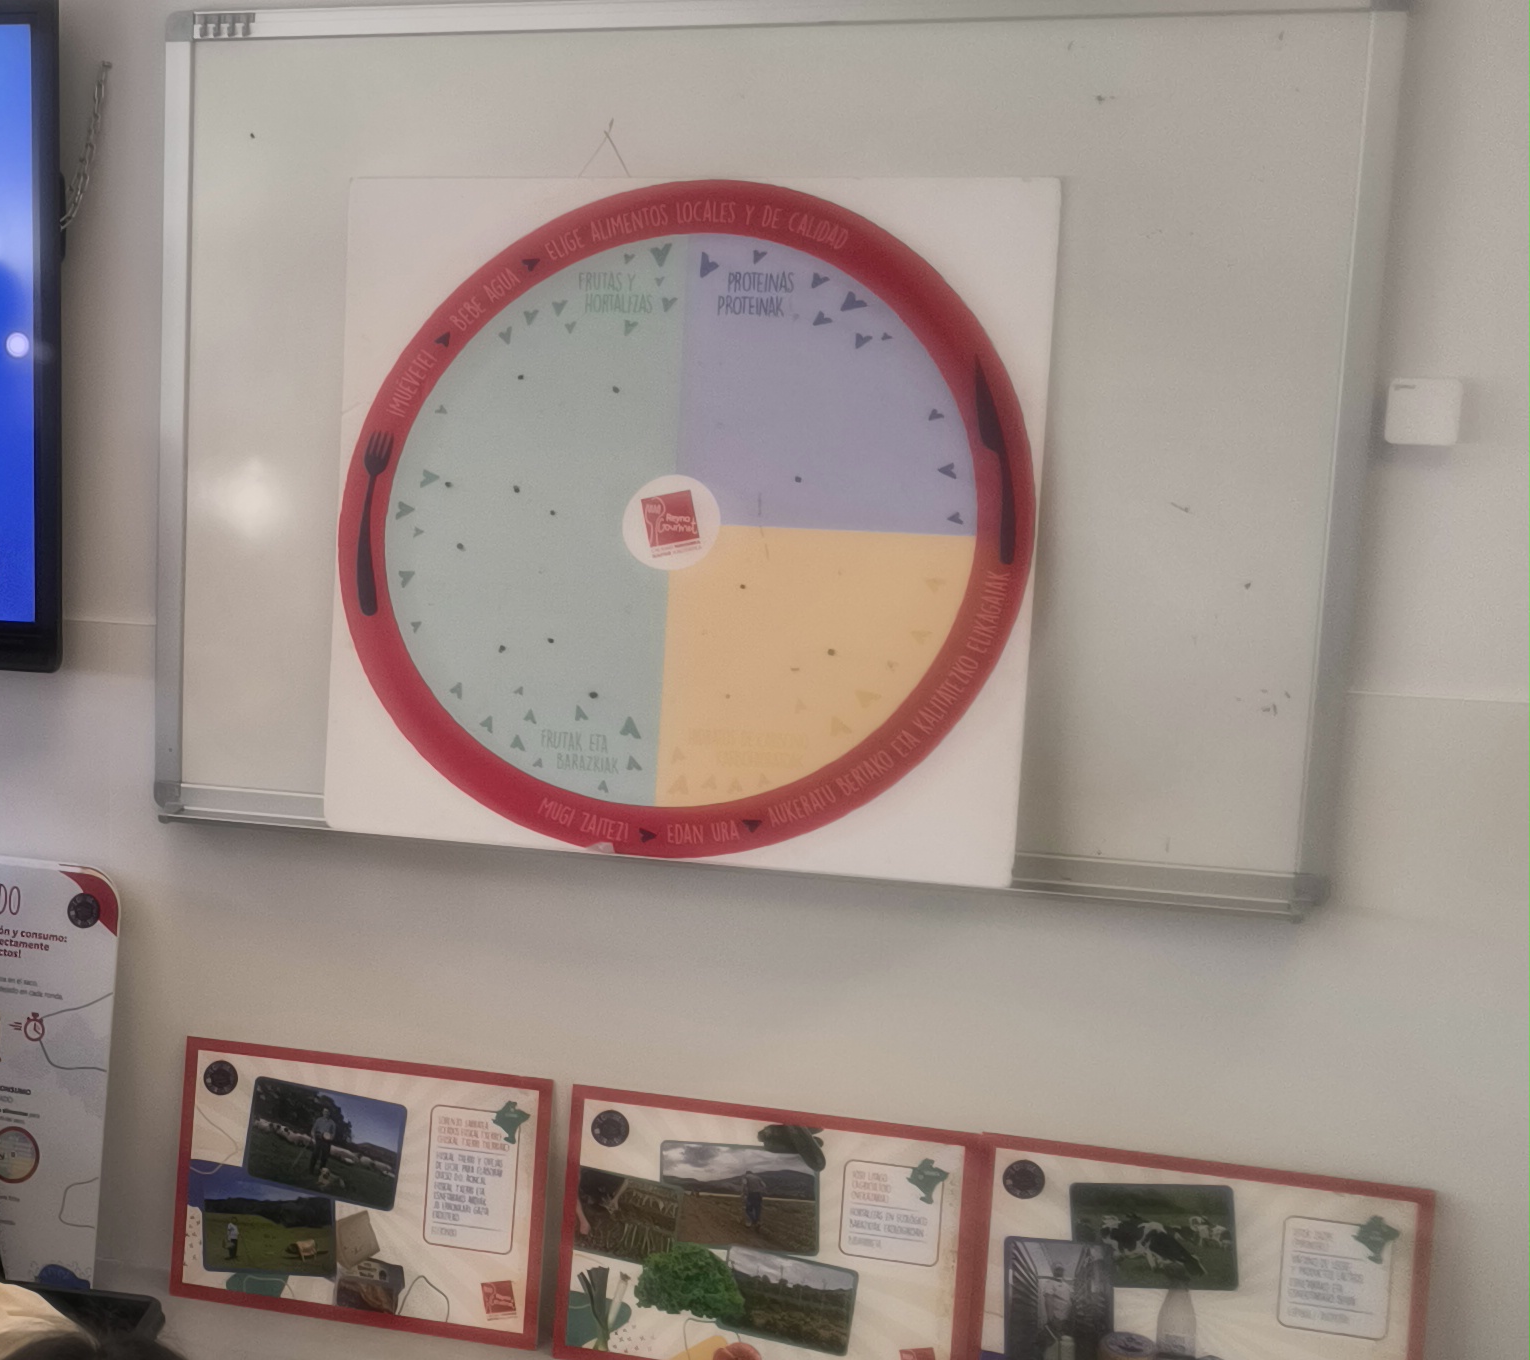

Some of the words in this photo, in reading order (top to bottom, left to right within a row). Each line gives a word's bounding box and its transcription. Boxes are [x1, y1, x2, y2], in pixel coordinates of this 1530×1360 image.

[544, 228, 586, 261] ELIGE
[590, 202, 668, 241] ALIMENTOS
[676, 200, 736, 225] LOCALES
[744, 202, 756, 224] Y
[761, 204, 780, 228] DE
[788, 212, 849, 251] CALIDAD
[578, 271, 622, 291] FRUTAS
[626, 272, 637, 291] Y
[727, 271, 795, 293] PROTEINAS
[449, 296, 487, 331] BEBE
[483, 267, 522, 304] AGUA
[584, 293, 654, 314] HORTALIZAS
[717, 295, 785, 317] PROTEINAK
[767, 785, 837, 827] AUKERATU
[890, 728, 921, 758] ETA
[912, 655, 979, 735] KALITATEZKO
[966, 570, 1011, 654] ELIKAGAIAK
[540, 728, 583, 751] FRUTAK
[588, 733, 609, 753] ETA
[556, 753, 620, 775] BARAZKIAK
[537, 797, 576, 827] MUGI
[667, 824, 704, 845] EDAN
[710, 820, 741, 842] URA
[12, 929, 18, 938] y
[20, 930, 68, 943] consumo:
